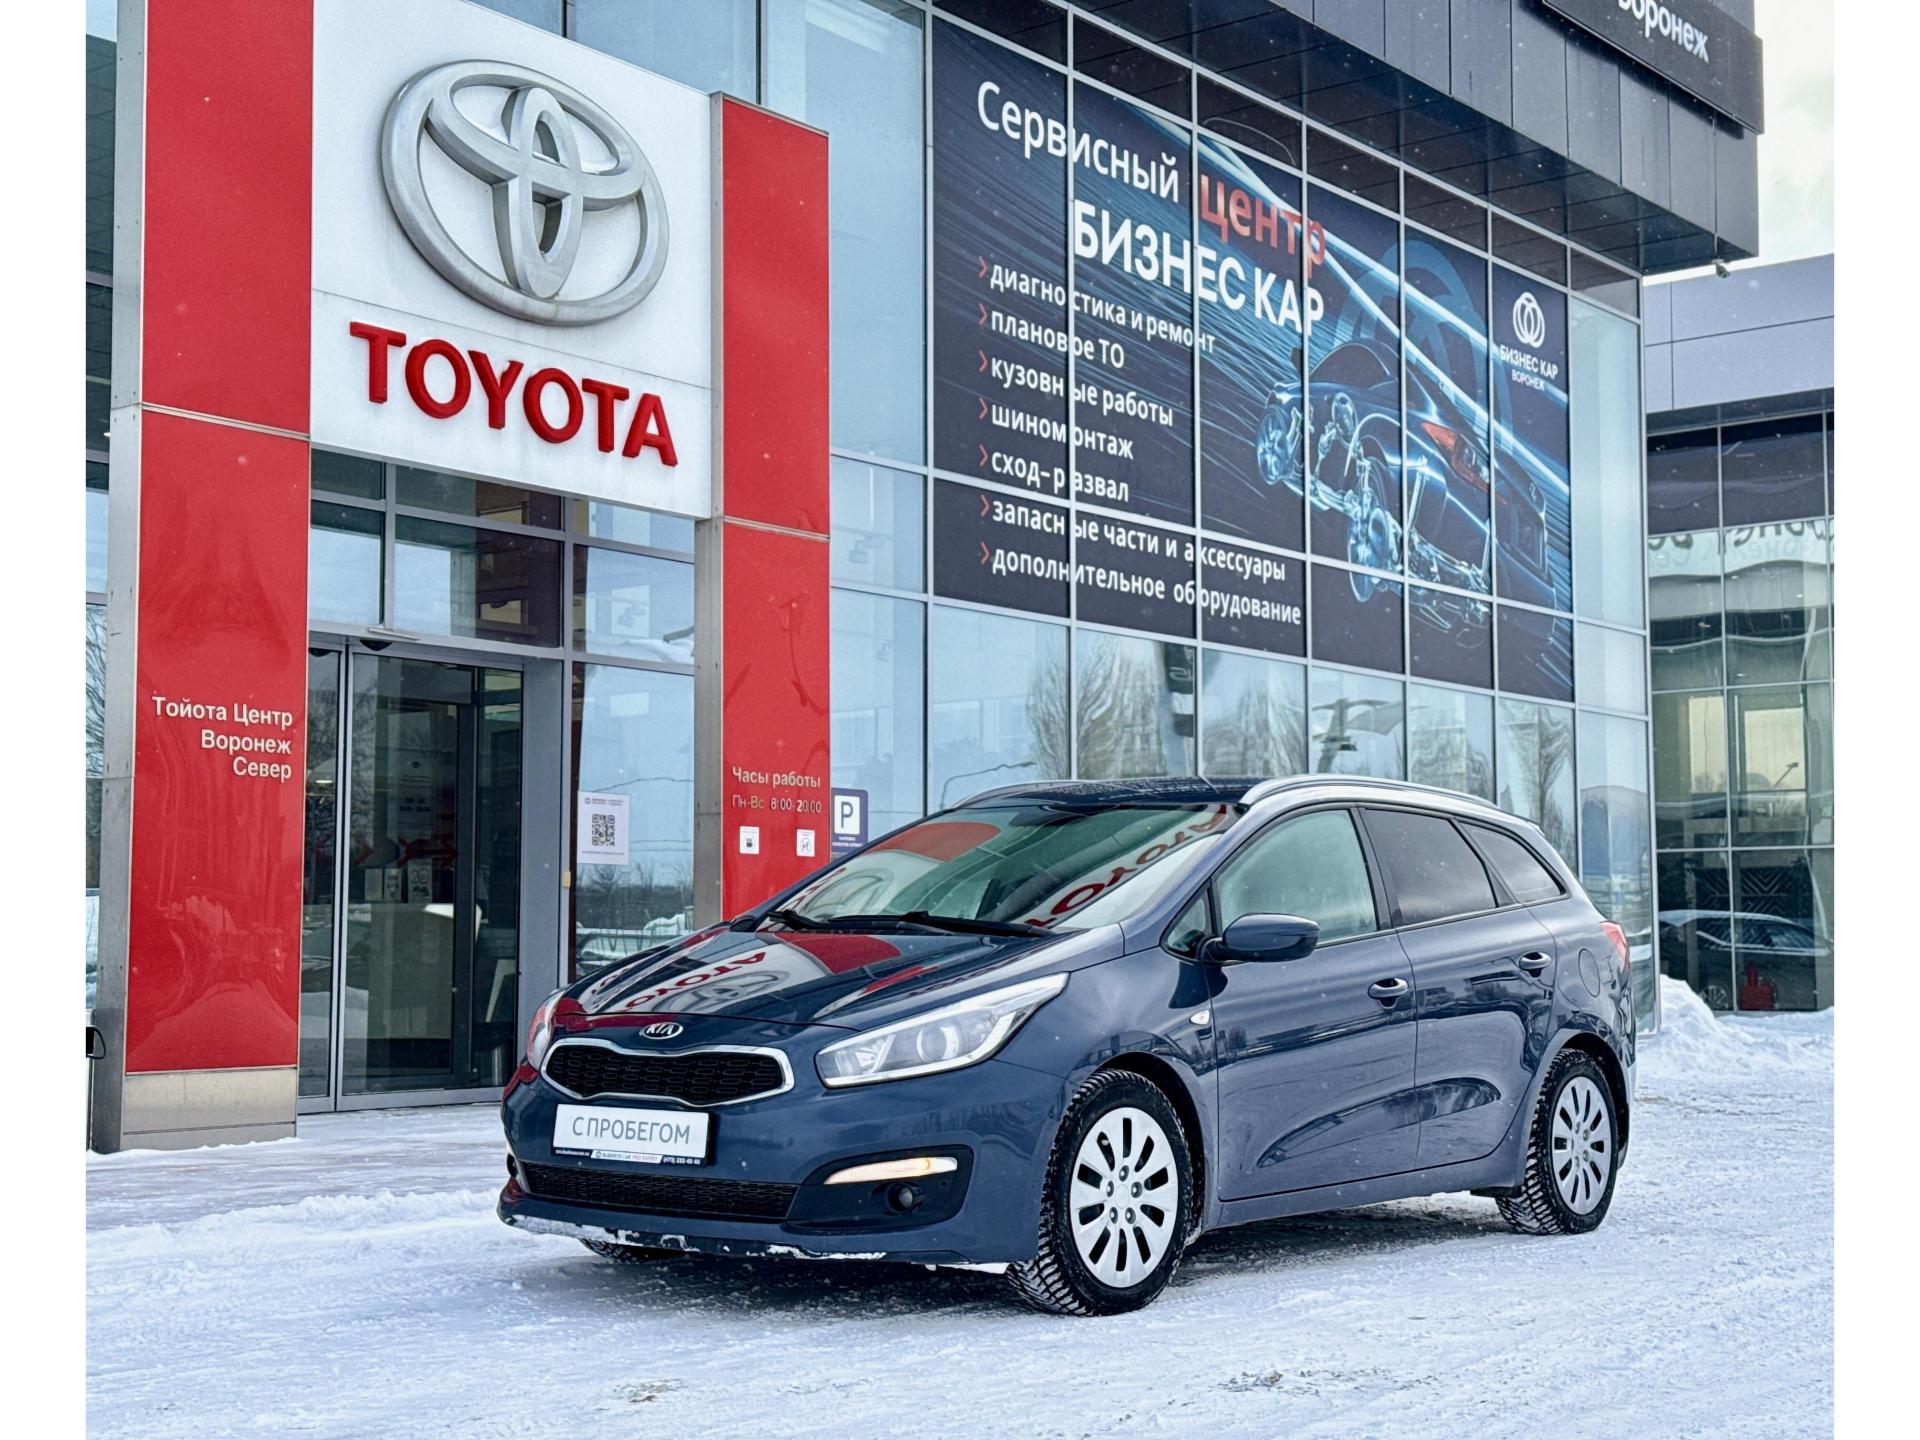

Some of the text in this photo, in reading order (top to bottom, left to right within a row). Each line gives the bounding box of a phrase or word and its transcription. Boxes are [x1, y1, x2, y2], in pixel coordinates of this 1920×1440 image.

[1618, 0, 1709, 63] оронеж
[978, 81, 1325, 279] Сервисный центр
[1073, 199, 1325, 336] БИЗНЕС КАР
[990, 264, 1216, 353] диагностика и ремонт
[991, 311, 1125, 369] плановое ТО
[1500, 344, 1558, 380] БИЗНЕС КАР
[349, 321, 678, 467] TOYOTA
[991, 357, 1173, 427] кузовные работы
[1512, 368, 1545, 392] ВОРОНЕЖ
[991, 404, 1134, 460] шиномонтаж
[992, 500, 1285, 584] запасные части и аксессуары
[992, 548, 1301, 625] дополнительное оборудование
[151, 696, 293, 731] Тойота Центр
[201, 729, 292, 755] Воронеж
[232, 756, 292, 783] Север
[732, 766, 821, 789] Часы работы
[841, 801, 854, 829] P
[644, 1022, 676, 1035] KIA
[572, 1116, 690, 1145] С ПРОБЕГОМ
